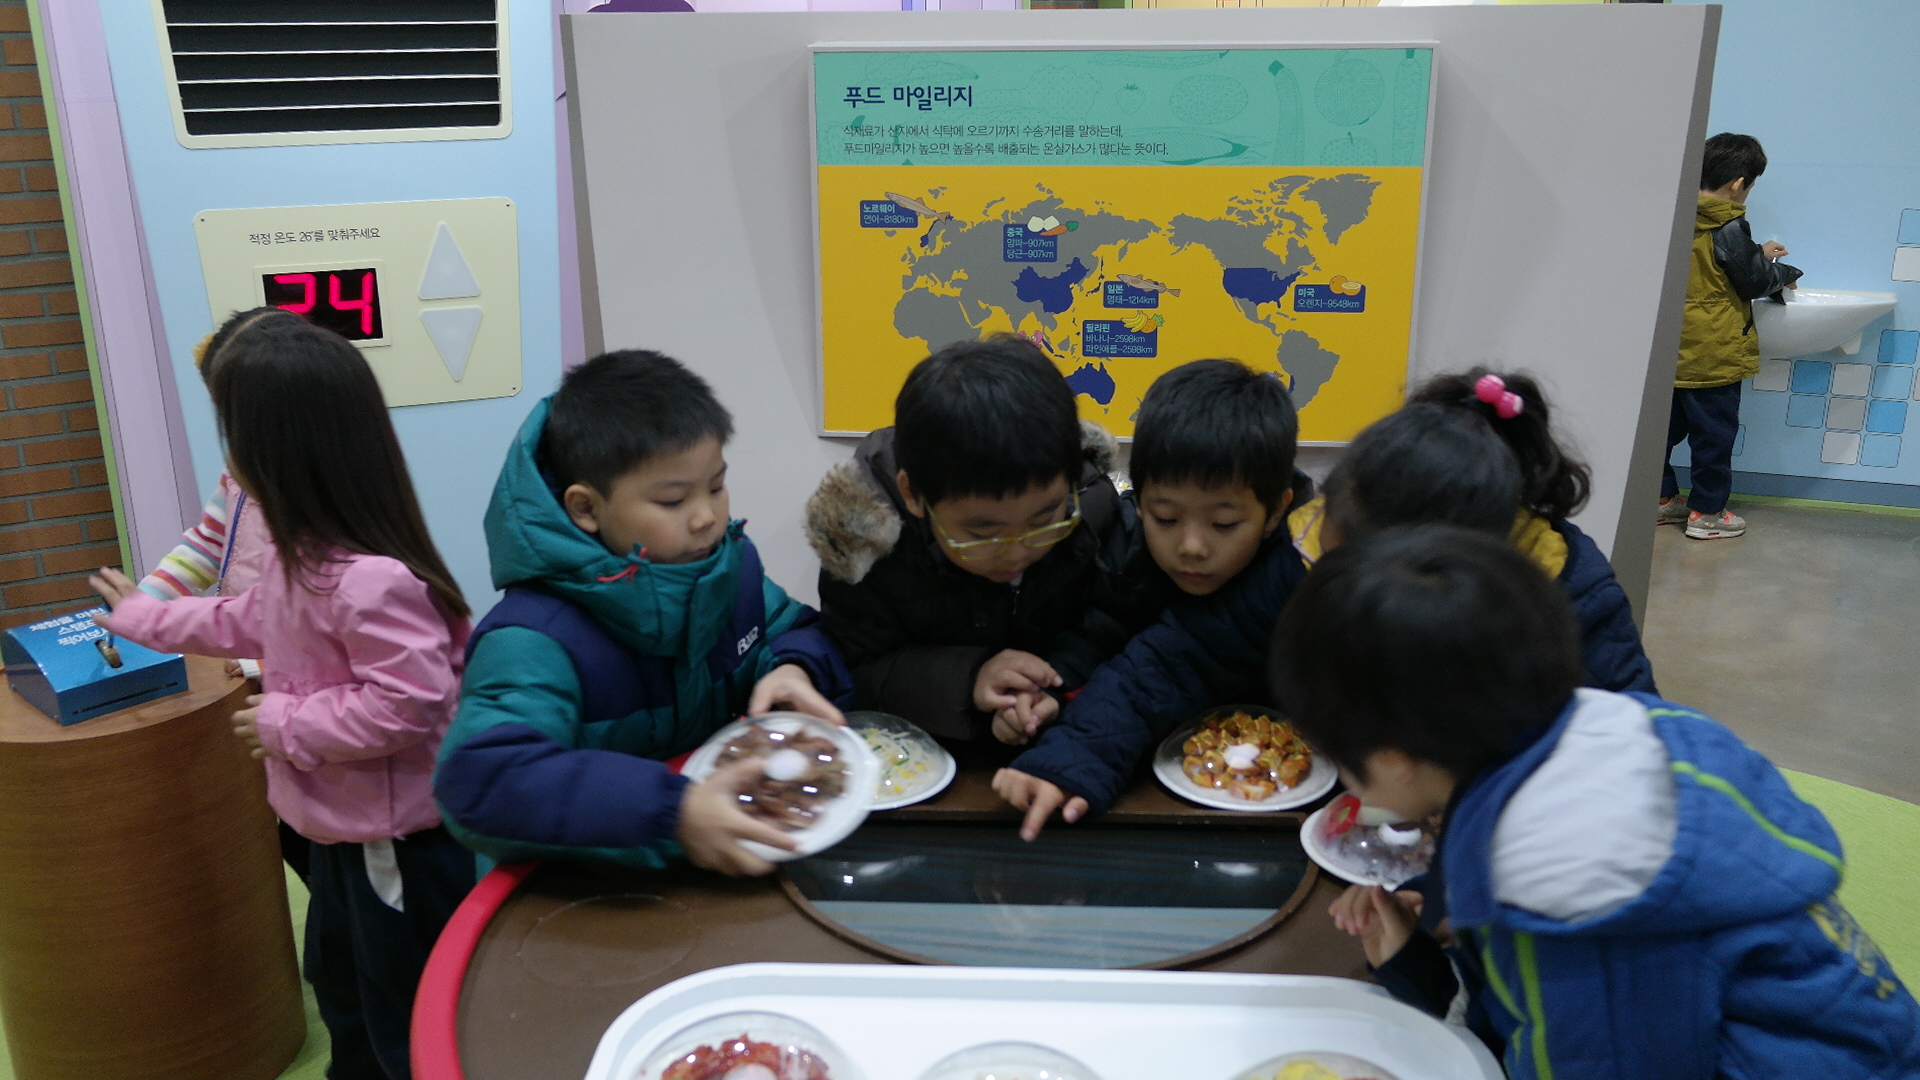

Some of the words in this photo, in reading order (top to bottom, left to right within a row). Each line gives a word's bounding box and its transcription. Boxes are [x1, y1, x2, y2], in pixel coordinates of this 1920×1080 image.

[843, 86, 885, 109] 푸드
[893, 85, 972, 111] 마일리지
[843, 124, 885, 138] 식재료가
[887, 124, 929, 138] 산지에서
[932, 124, 964, 138] 식탁에
[967, 124, 1019, 138] 오르기까지
[1022, 124, 1075, 138] 수송거리를
[1079, 124, 1123, 138] 말하는데,
[843, 142, 916, 156] 푸드마일리지가
[919, 142, 950, 156] 높으면
[953, 142, 995, 156] 높을수록
[998, 142, 1040, 156] 배출되는
[1042, 142, 1096, 156] 온실가스가
[1099, 142, 1132, 156] 많다는
[1134, 142, 1169, 156] 뜻이다.
[863, 203, 896, 214] 노르웨이
[249, 232, 271, 246] 적정
[274, 231, 297, 244] 온도
[327, 227, 381, 242] 맞춰주세요
[1006, 227, 1024, 238] 중국
[1107, 284, 1124, 294] 일본
[1297, 287, 1316, 298] 미국
[1085, 323, 1110, 333] 필리핀
